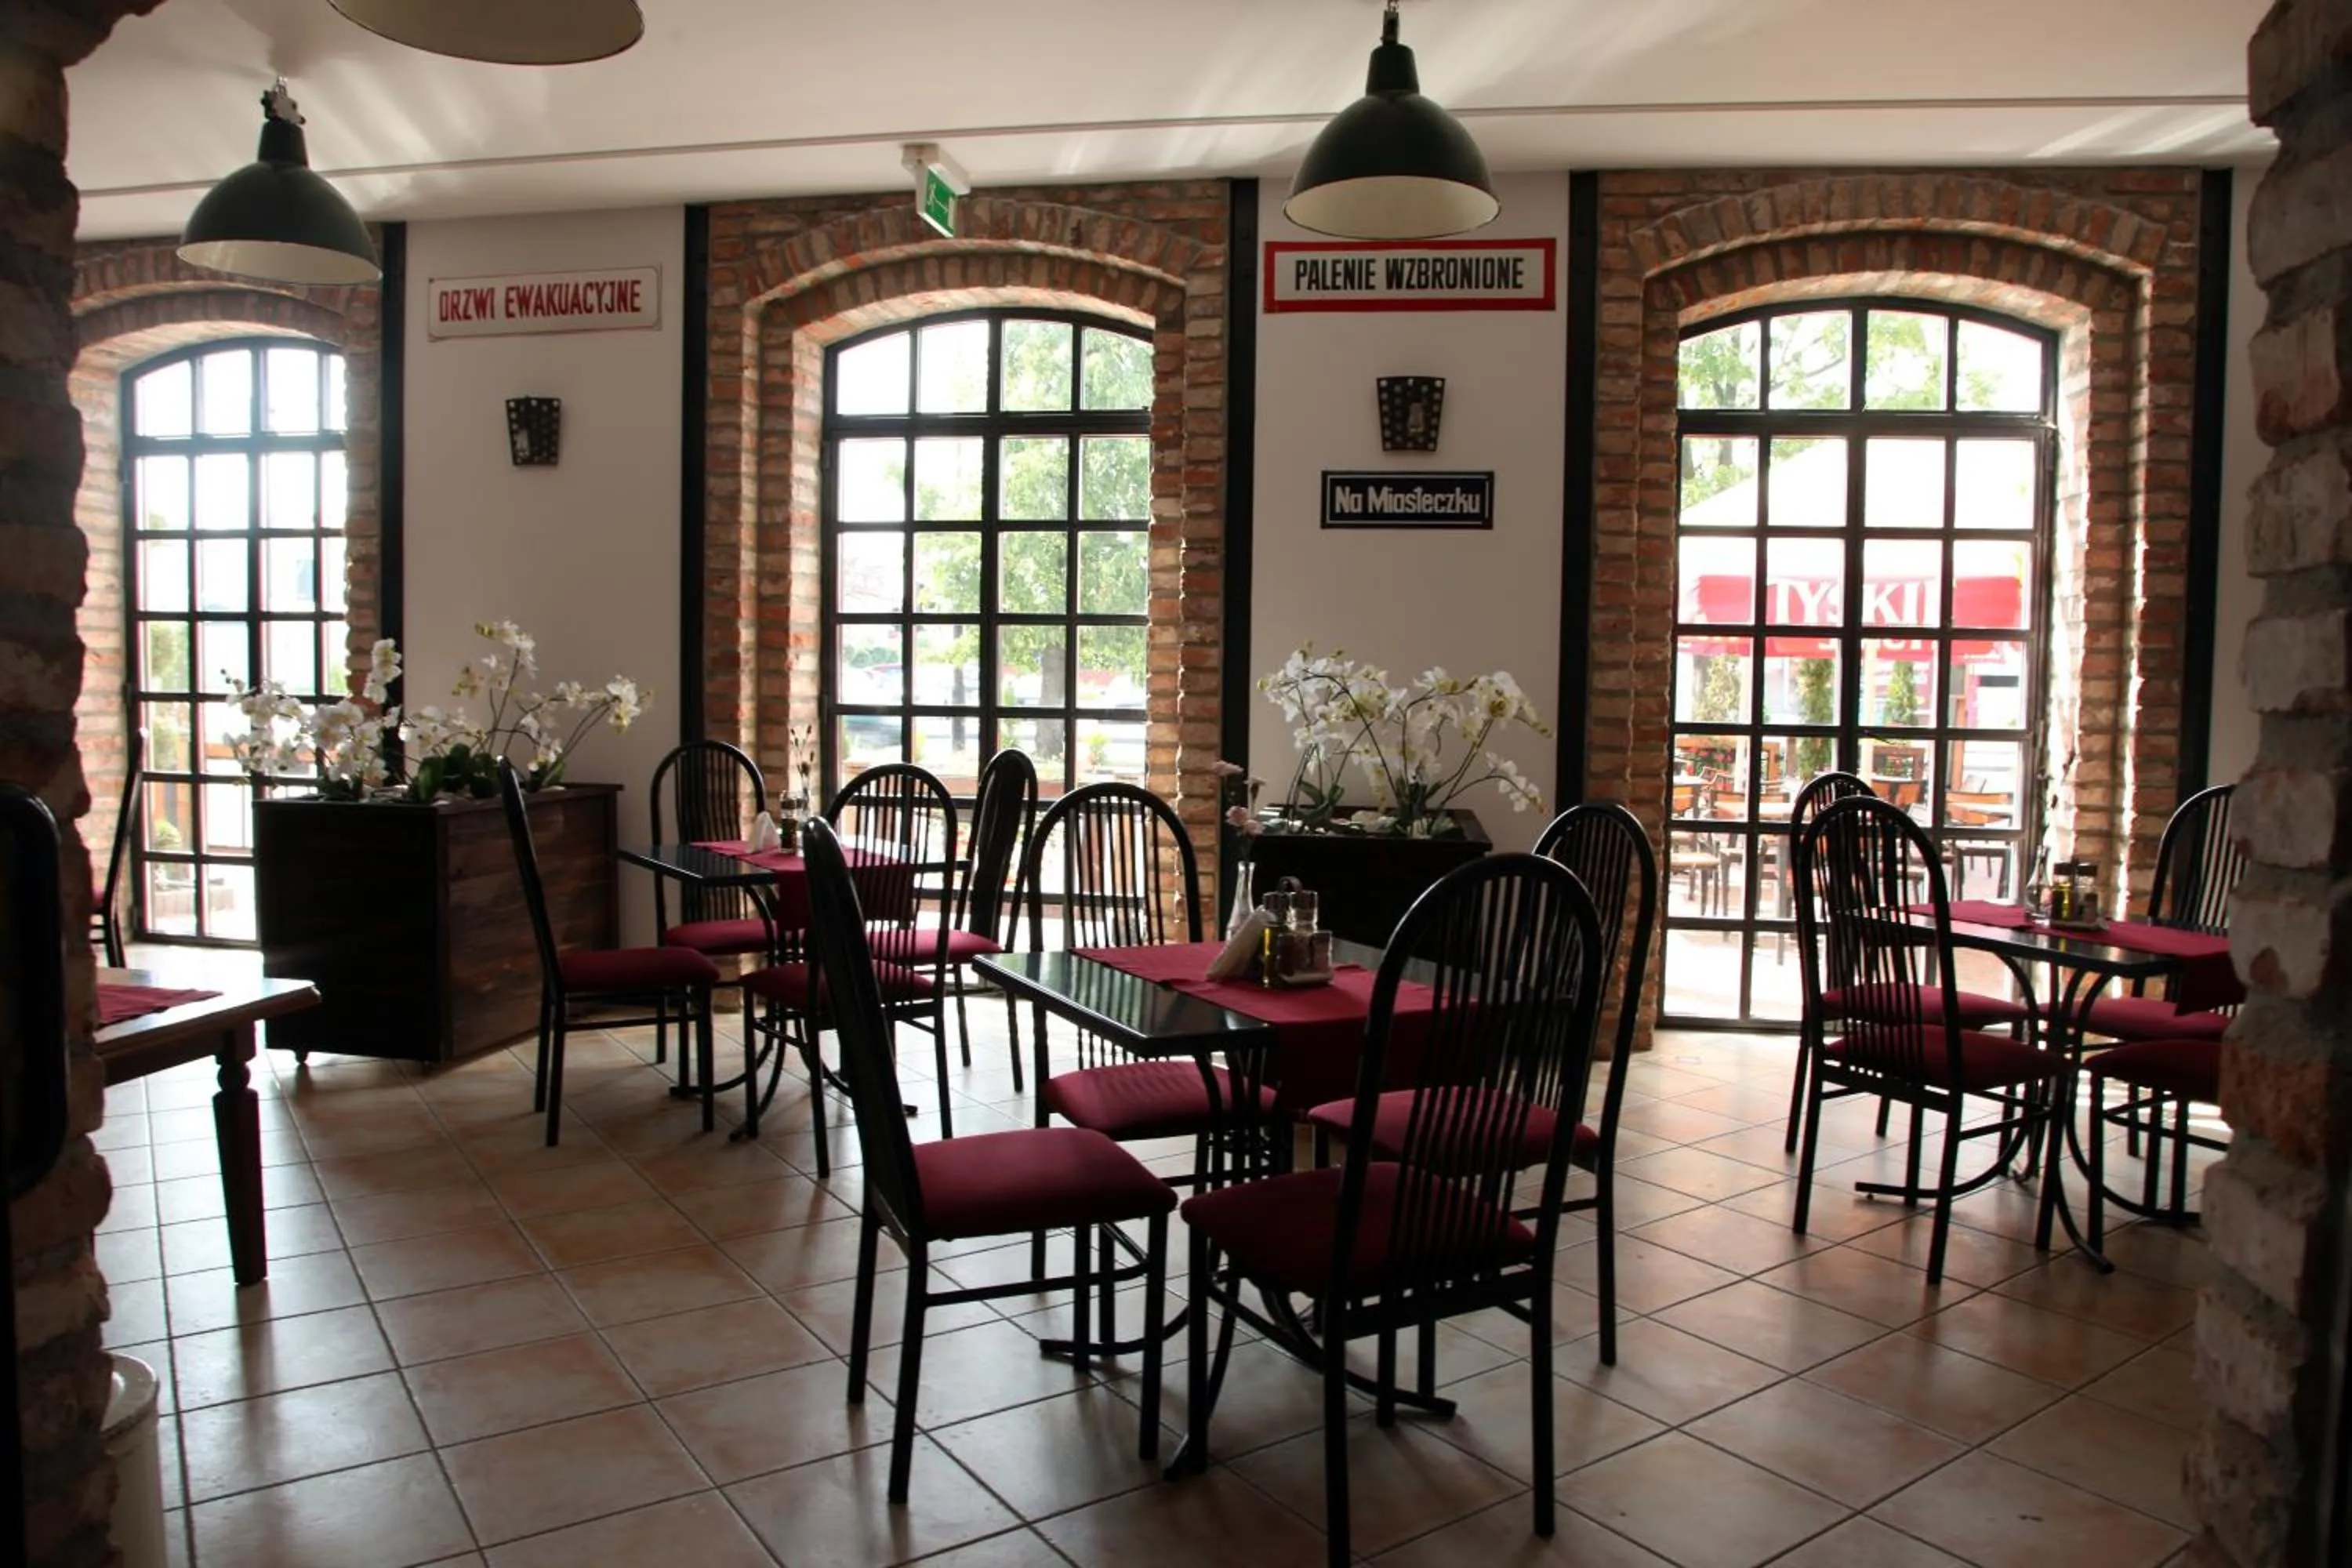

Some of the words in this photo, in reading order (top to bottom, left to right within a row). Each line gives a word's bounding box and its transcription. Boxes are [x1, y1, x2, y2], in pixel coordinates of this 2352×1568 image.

[1294, 258, 1377, 291] PALENIE
[1385, 257, 1524, 290] WZBRONIONE
[438, 287, 496, 322] DRZWI
[503, 280, 642, 318] EWAKUACYJNE
[1335, 486, 1363, 514] Na
[1367, 486, 1480, 514] Miasteczku
